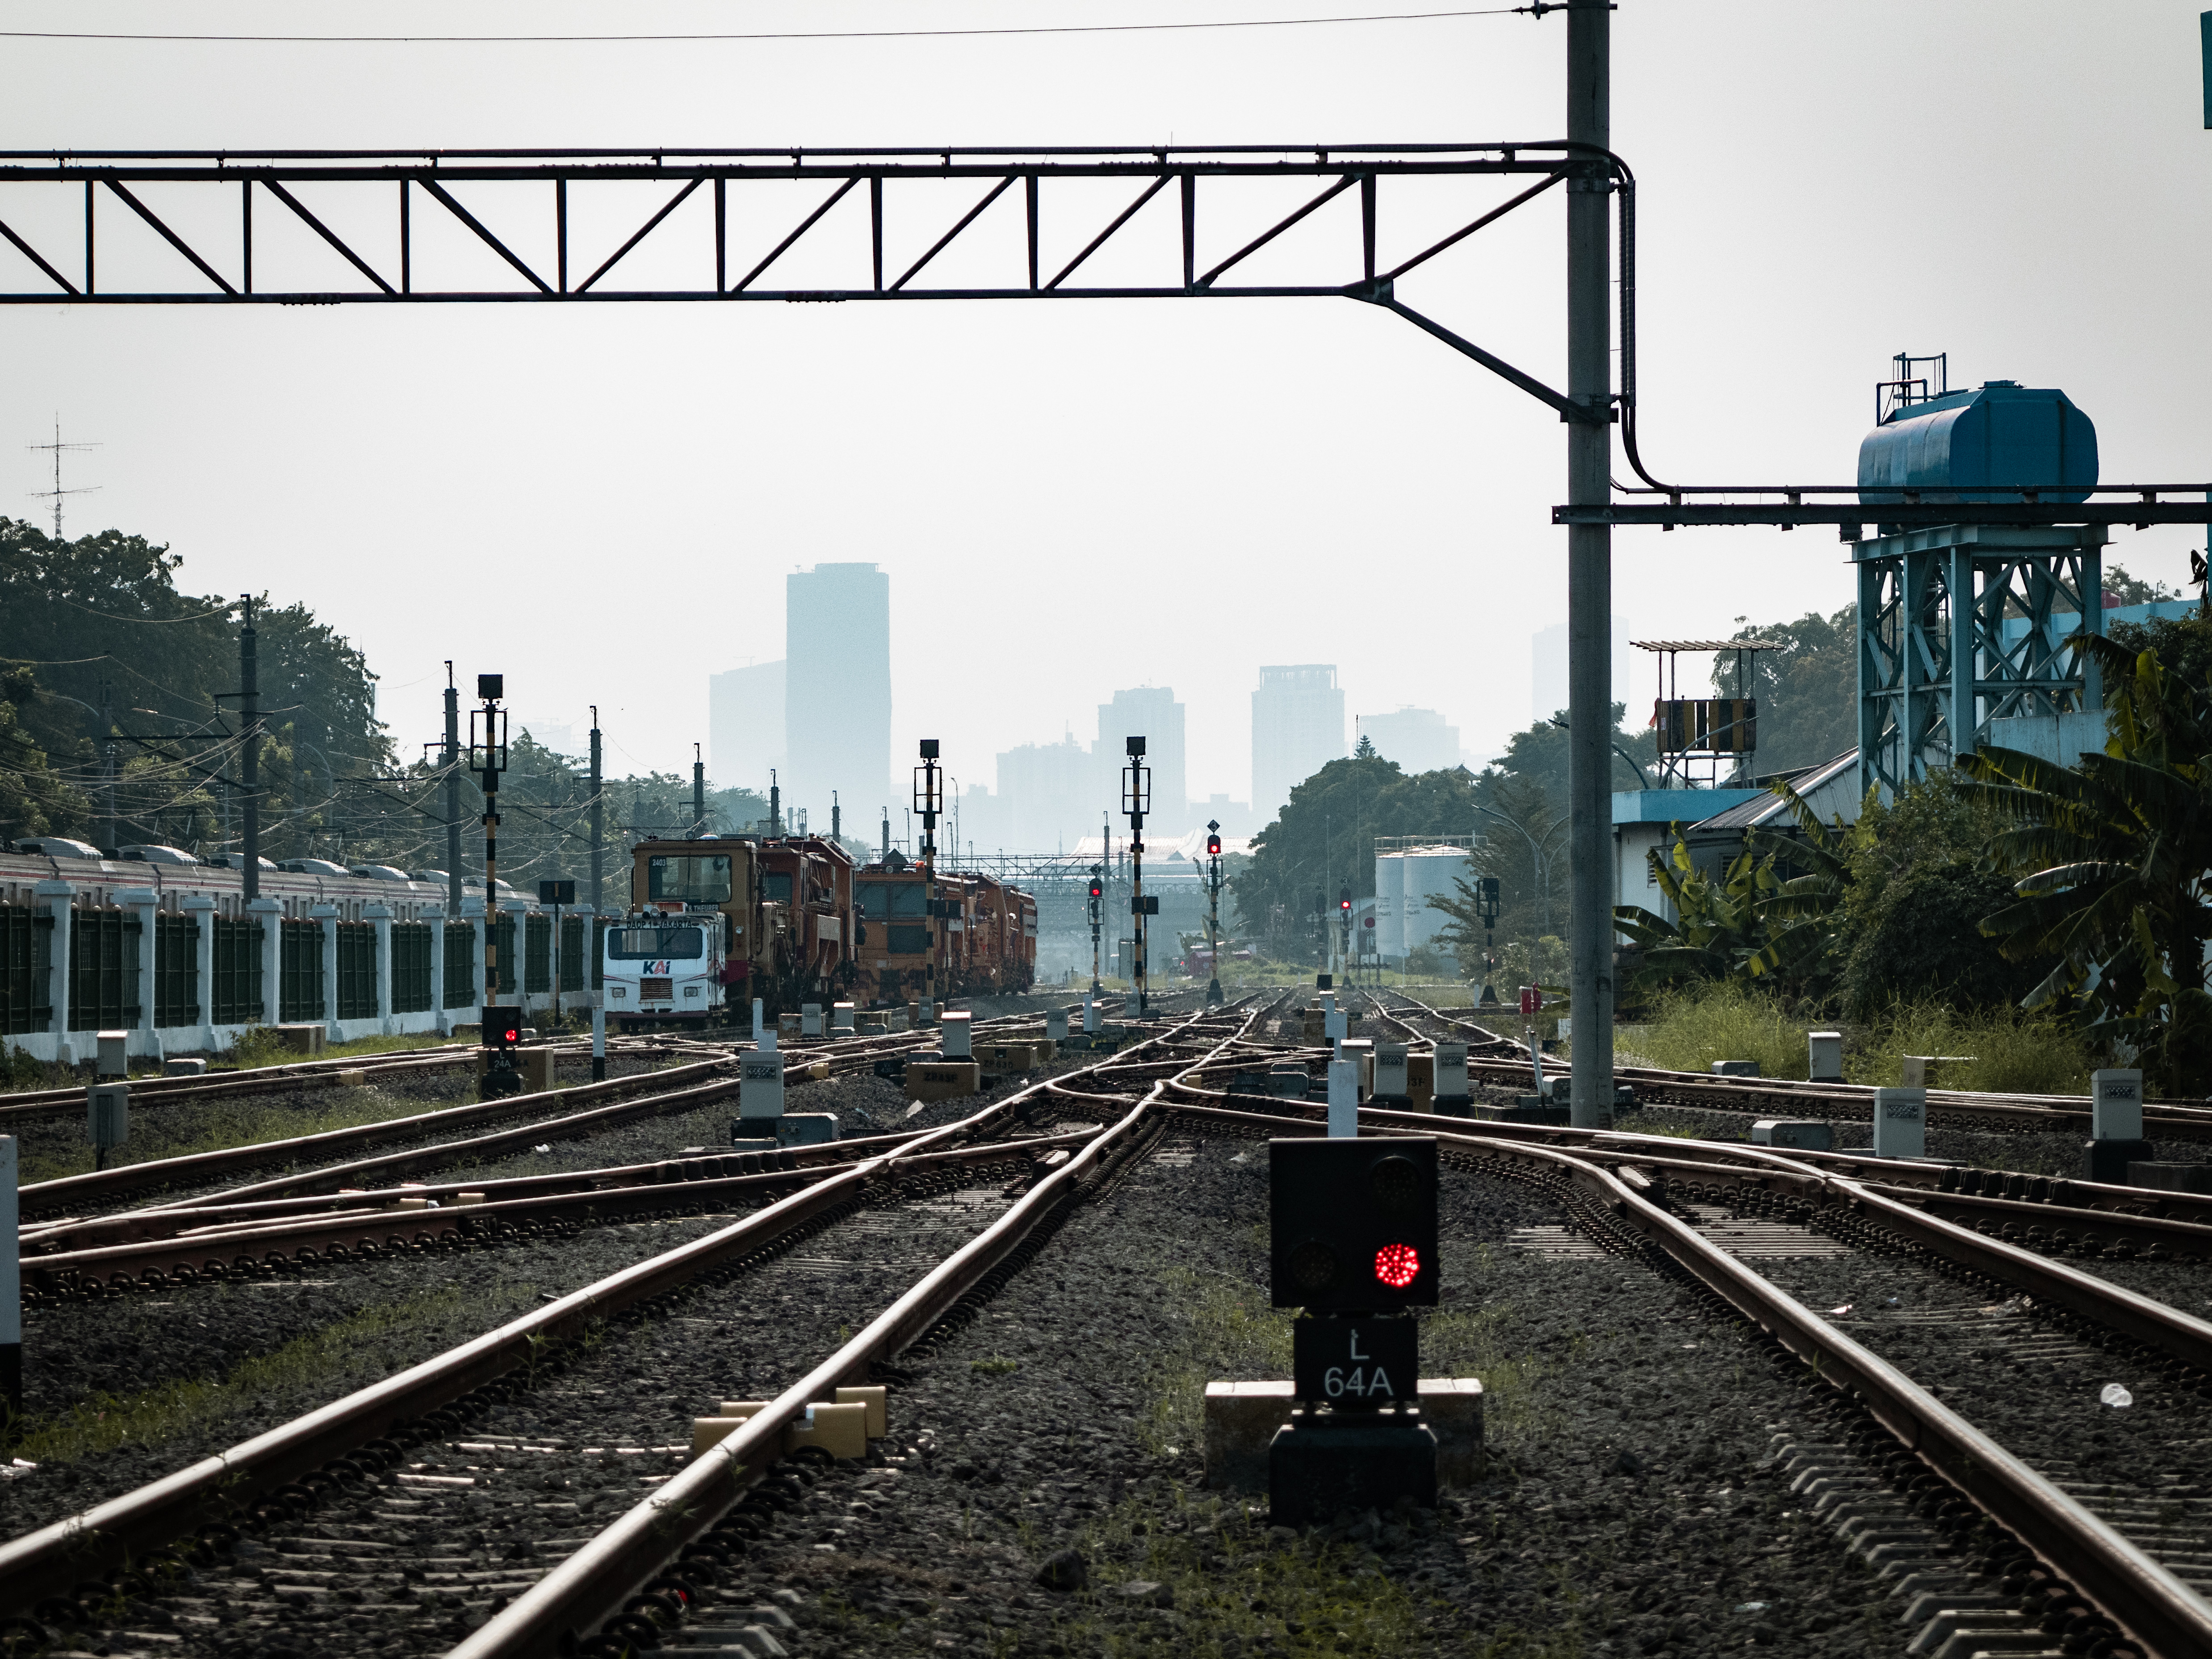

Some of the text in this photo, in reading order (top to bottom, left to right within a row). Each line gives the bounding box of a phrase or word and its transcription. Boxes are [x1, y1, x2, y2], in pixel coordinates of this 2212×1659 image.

[1211, 821, 1217, 830] 3
[652, 859, 666, 867] 2403
[1093, 866, 1099, 875] 3
[1342, 877, 1348, 885] 3
[660, 920, 692, 929] JAKARTA
[643, 960, 671, 974] KAI
[499, 1051, 505, 1059] L
[494, 1060, 511, 1068] 24A
[1351, 1328, 1370, 1360] L
[1324, 1366, 1394, 1397] 64A
